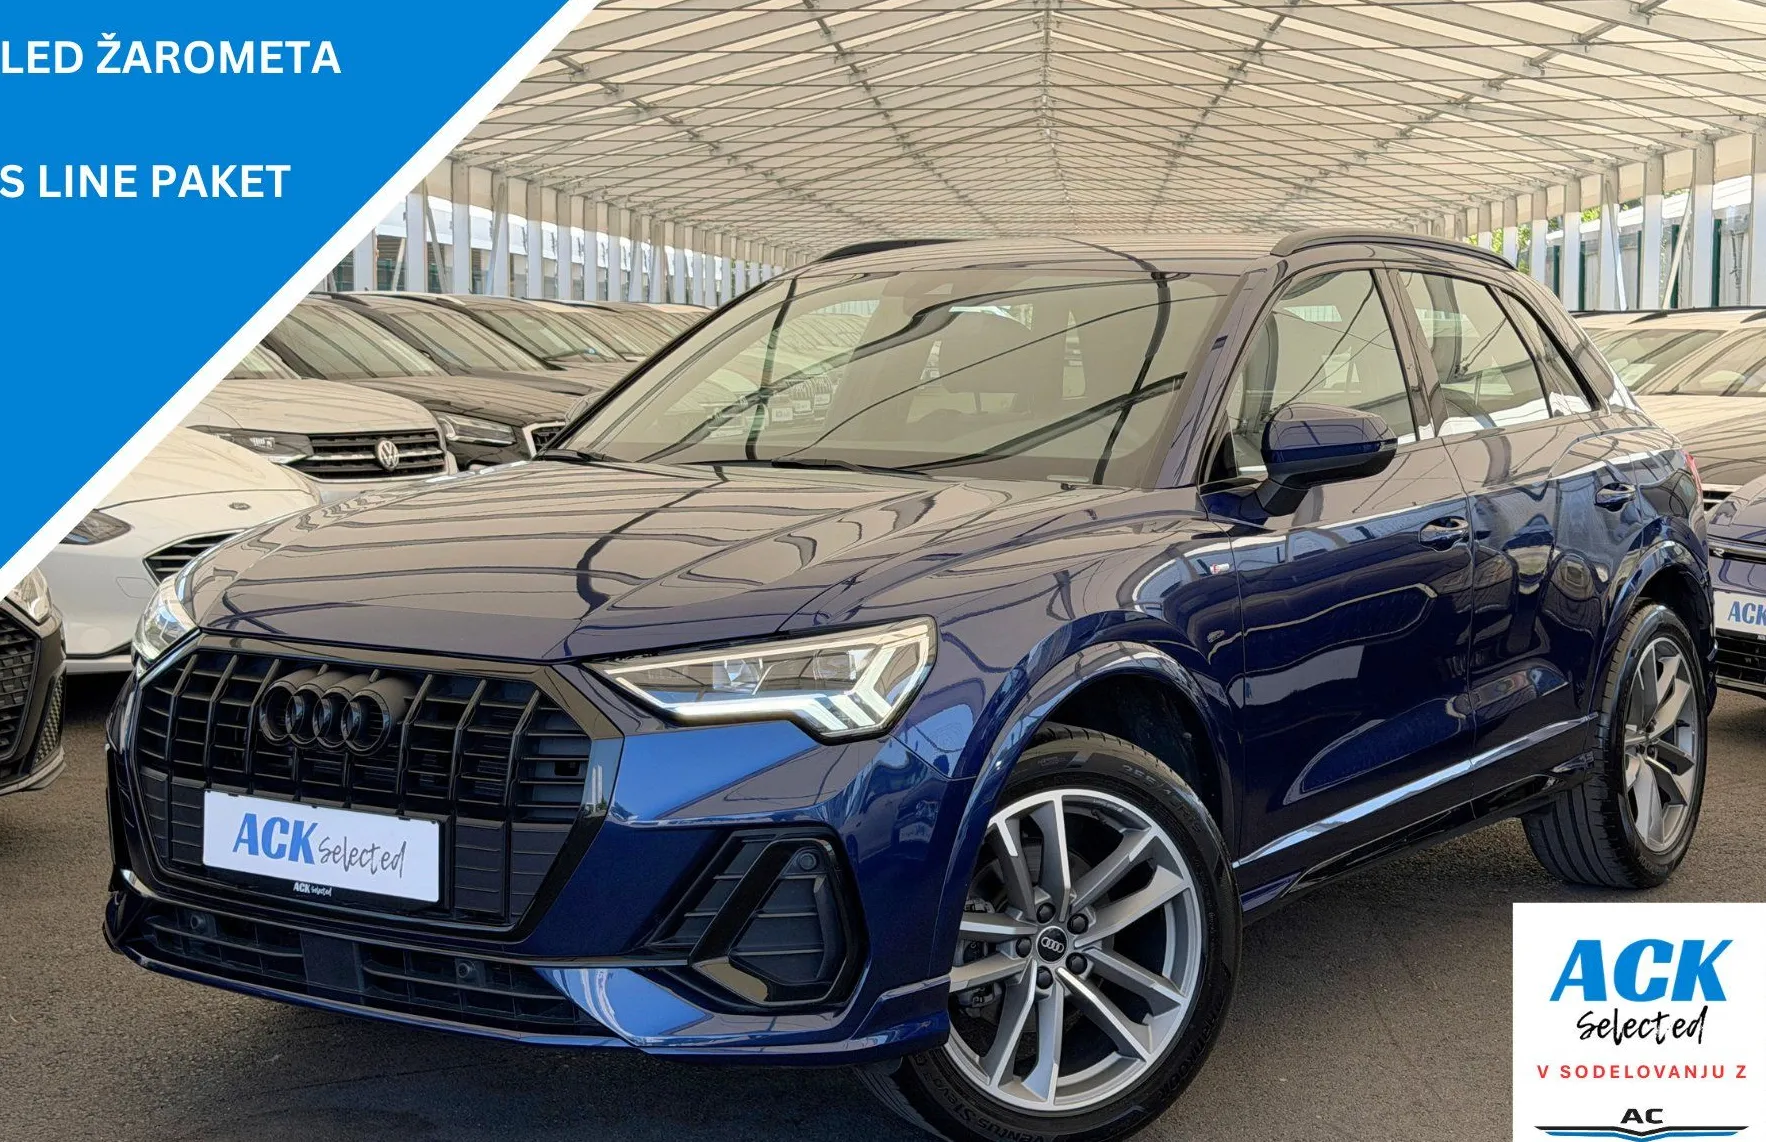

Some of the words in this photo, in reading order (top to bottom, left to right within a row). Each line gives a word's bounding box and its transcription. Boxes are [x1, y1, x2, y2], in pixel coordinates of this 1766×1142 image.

[1727, 601, 1766, 627] ACK
[232, 812, 318, 866] ACK
[318, 836, 407, 879] Selected
[292, 882, 311, 894] ACK
